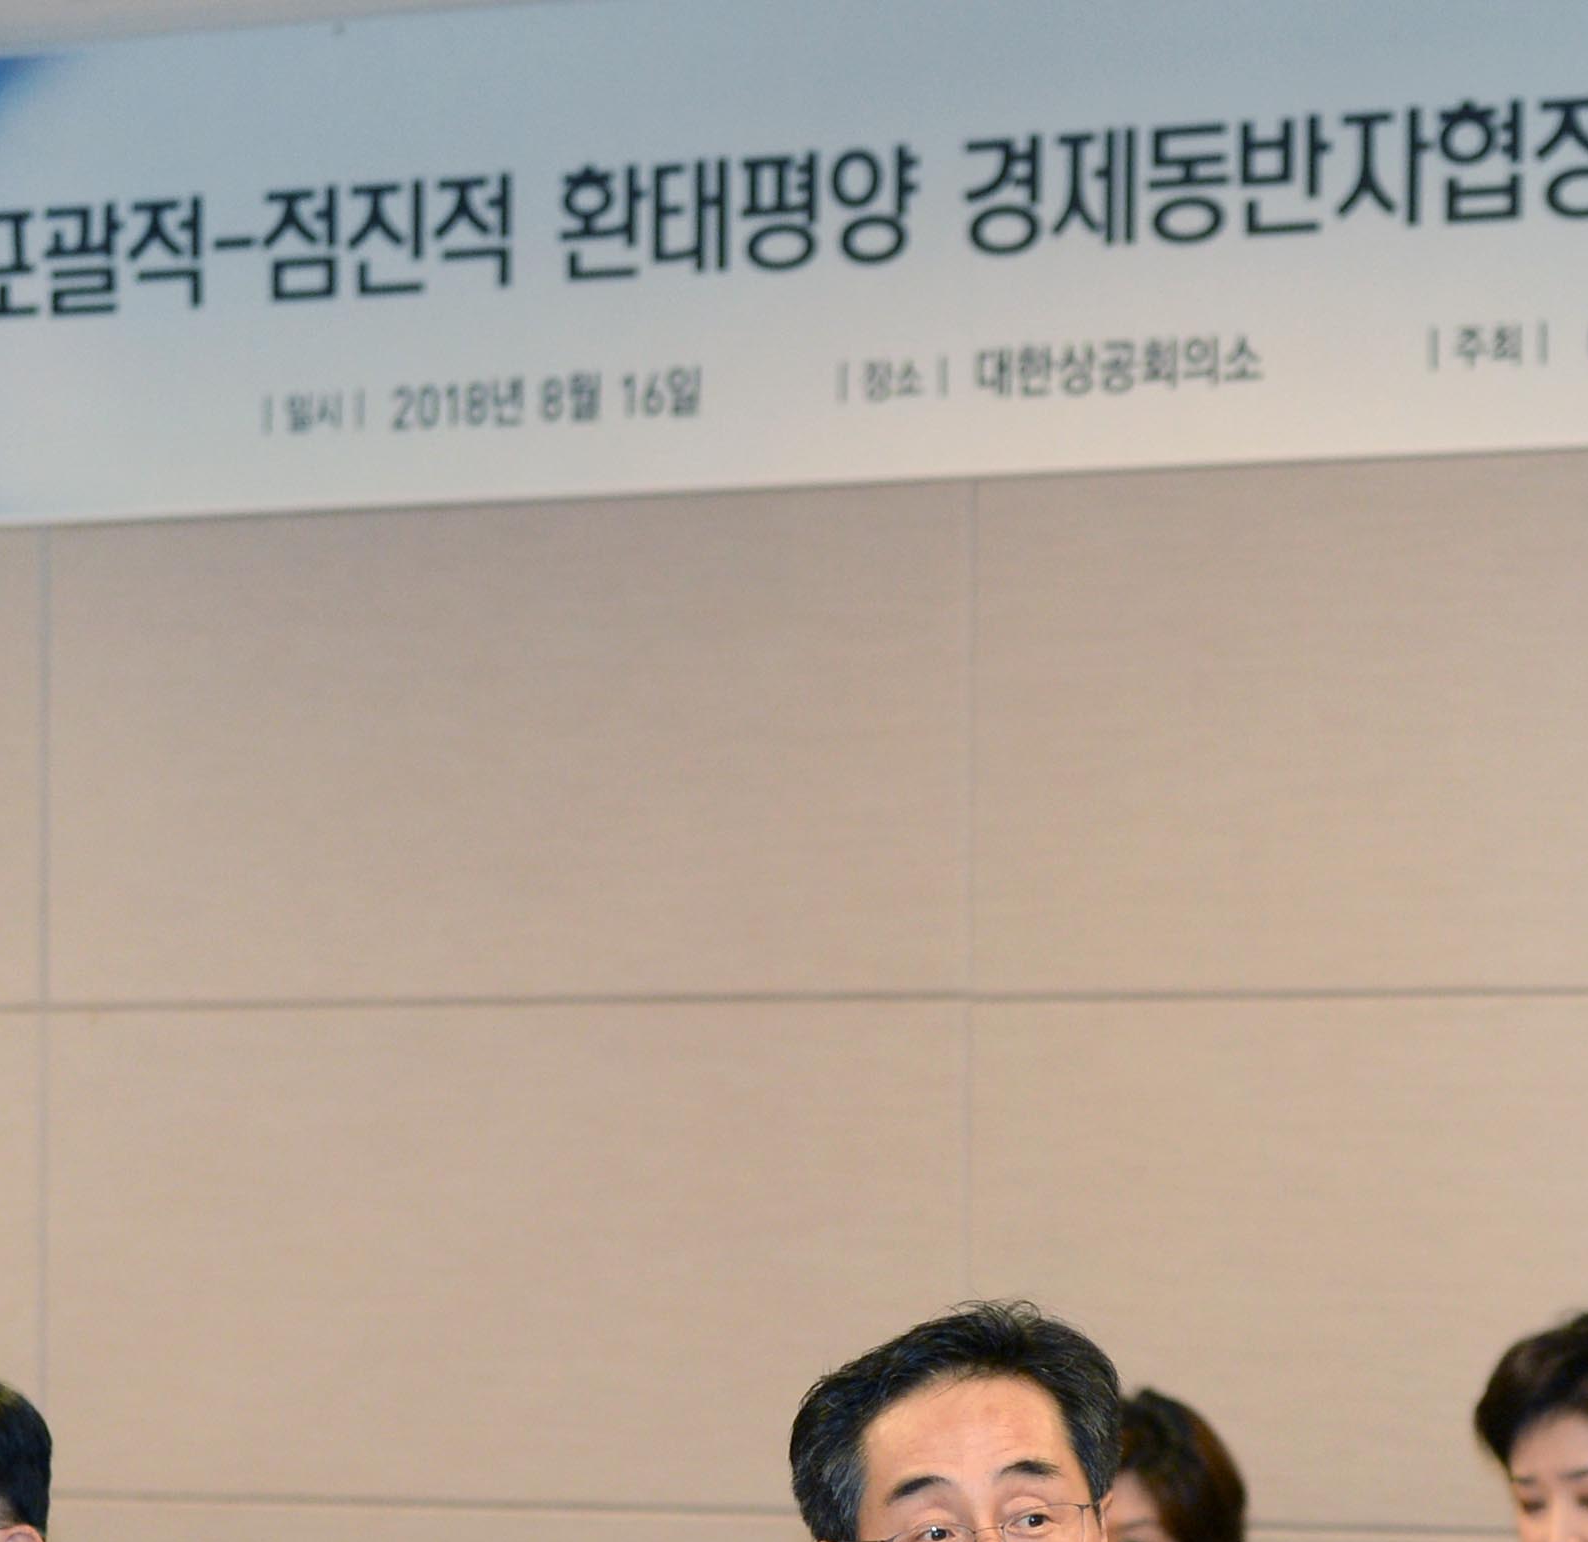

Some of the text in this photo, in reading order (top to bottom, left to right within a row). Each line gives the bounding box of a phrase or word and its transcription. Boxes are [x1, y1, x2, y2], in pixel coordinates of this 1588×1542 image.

[560, 144, 918, 281] 환태평양
[975, 336, 1261, 397] 대한상공회의소
[392, 377, 524, 431] 2018년
[541, 373, 601, 422] 8월
[622, 367, 701, 417] 16일
